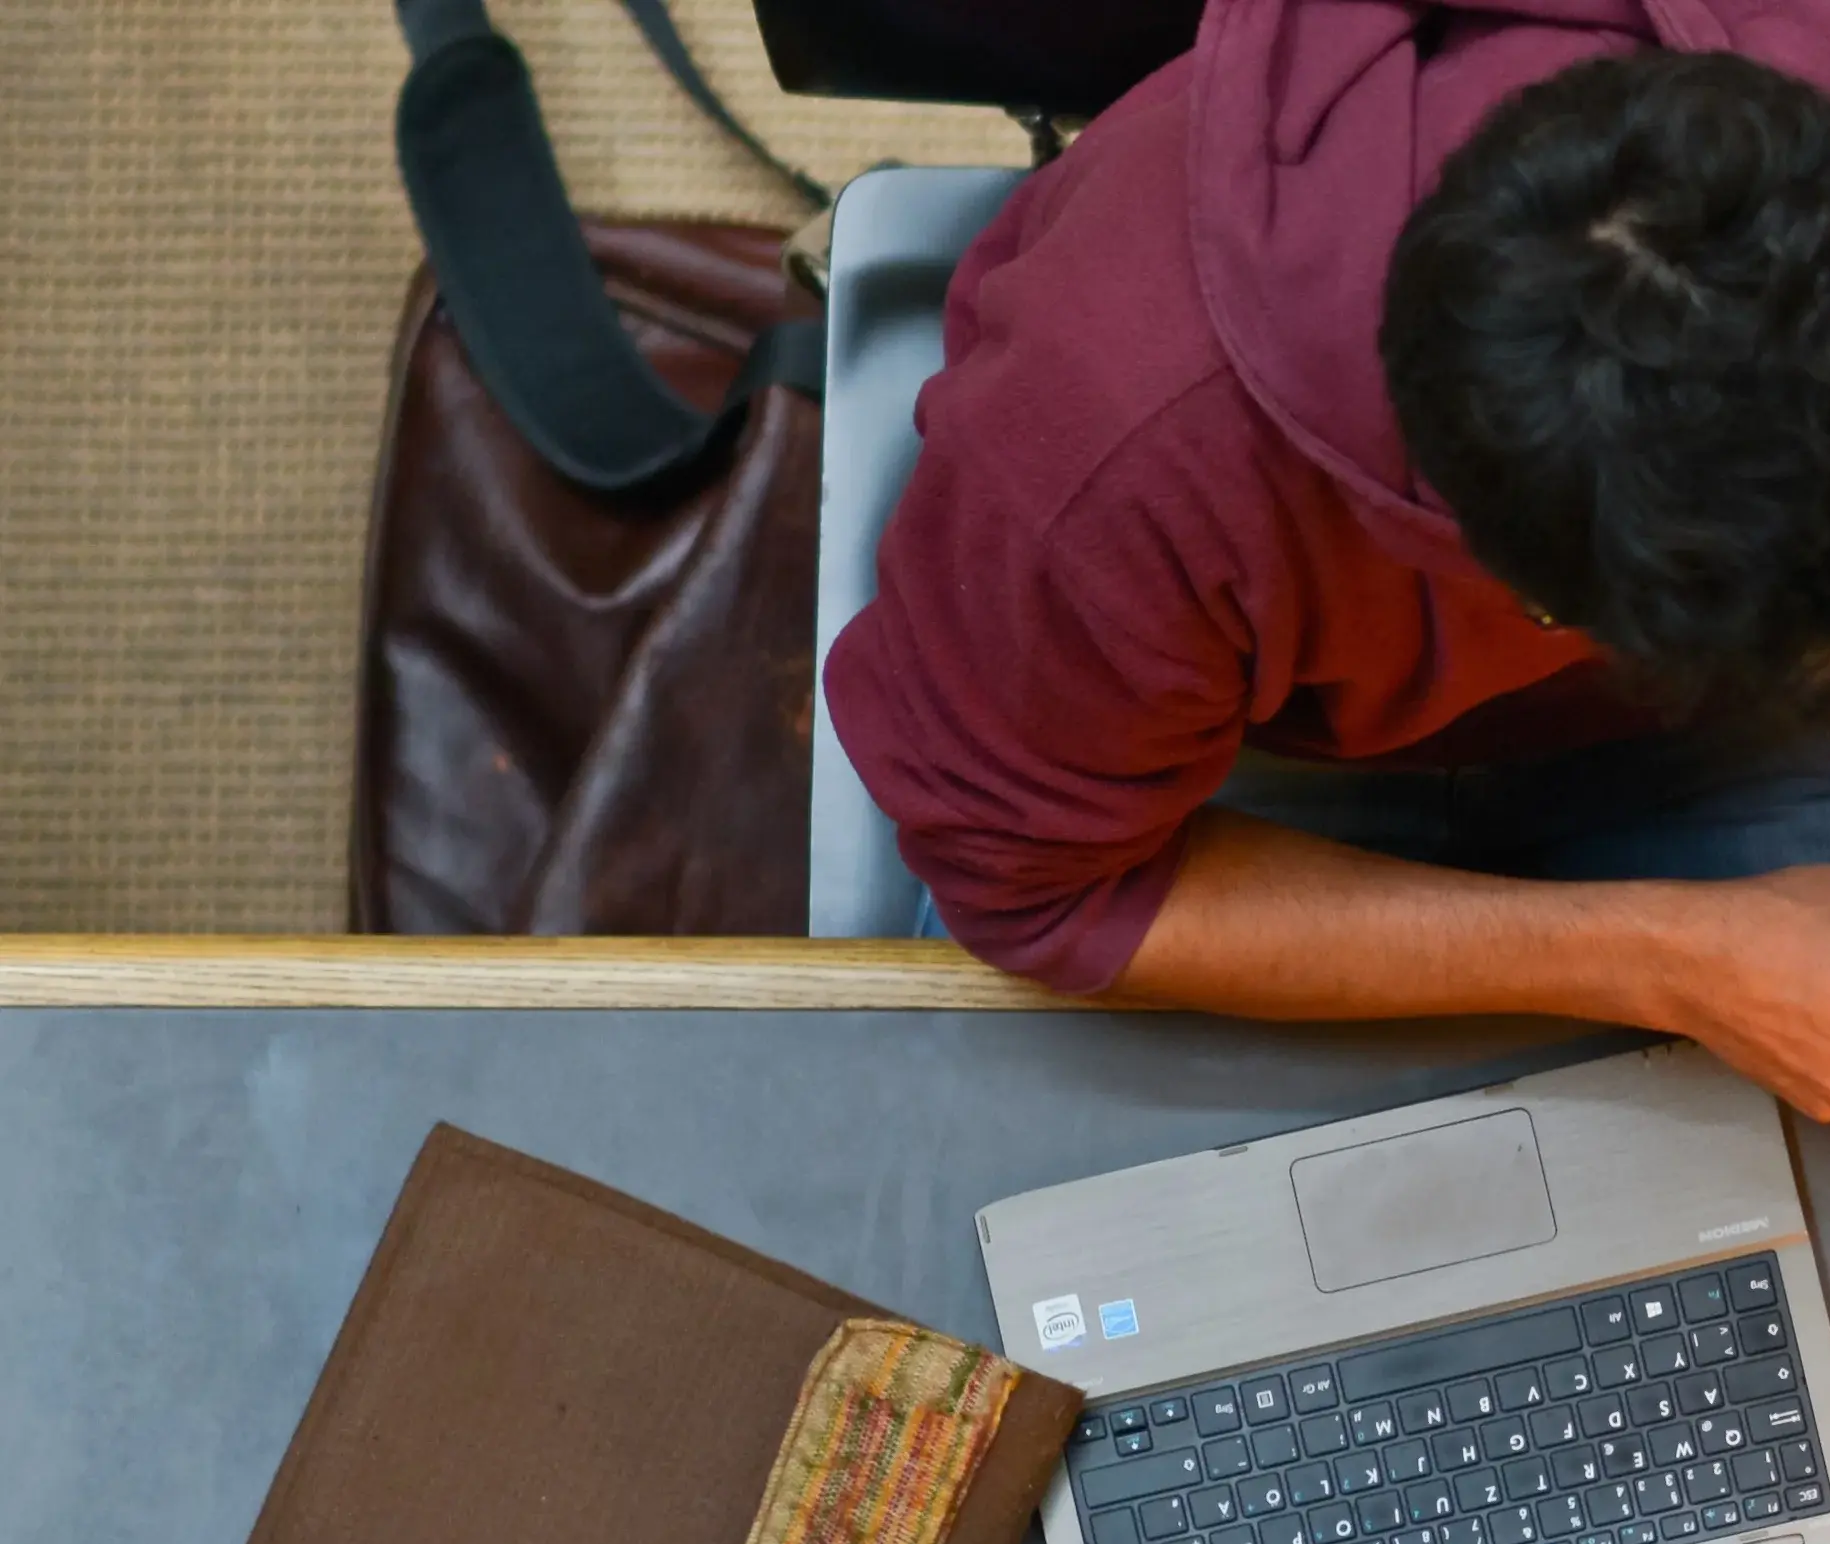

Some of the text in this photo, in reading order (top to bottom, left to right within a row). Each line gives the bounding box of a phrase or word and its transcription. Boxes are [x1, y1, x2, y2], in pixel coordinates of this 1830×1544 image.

[1698, 1218, 1768, 1242] MEDION
[1749, 1278, 1769, 1290] Strg
[1707, 1289, 1720, 1299] Fn
[1608, 1311, 1621, 1323] Alt
[1047, 1318, 1075, 1335] intel
[1673, 1351, 1685, 1367] Y
[1622, 1362, 1635, 1379] X
[1301, 1378, 1330, 1394] Alt Gr
[1573, 1373, 1587, 1390] C
[1527, 1385, 1539, 1402] V
[1703, 1387, 1717, 1404] A
[1214, 1402, 1234, 1414] Strg
[1478, 1395, 1489, 1412] B
[1658, 1399, 1669, 1416] S
[1426, 1406, 1441, 1424] N
[1607, 1410, 1621, 1427] D
[1374, 1418, 1391, 1436] M
[1563, 1422, 1573, 1439] F
[1508, 1433, 1524, 1450] G
[1724, 1429, 1741, 1445] Q
[1461, 1445, 1475, 1462] H
[1675, 1440, 1693, 1458] W
[1632, 1451, 1643, 1468] E
[1712, 1461, 1722, 1475] 2
[1364, 1467, 1378, 1484] K
[1583, 1462, 1594, 1479] R
[1319, 1479, 1329, 1495] L
[1536, 1474, 1547, 1490] T
[1664, 1473, 1673, 1486] 3
[1484, 1484, 1497, 1502] Z
[1615, 1485, 1624, 1497] 4
[1798, 1487, 1817, 1502] ESC
[1435, 1496, 1449, 1513] U
[1566, 1496, 1575, 1509] 5
[1767, 1501, 1778, 1513] F1
[1518, 1507, 1527, 1520] 6
[1724, 1511, 1736, 1522] F2
[1335, 1519, 1351, 1536] O
[1682, 1520, 1695, 1532] F3
[1421, 1530, 1430, 1543] 8
[1641, 1530, 1653, 1541] F4
